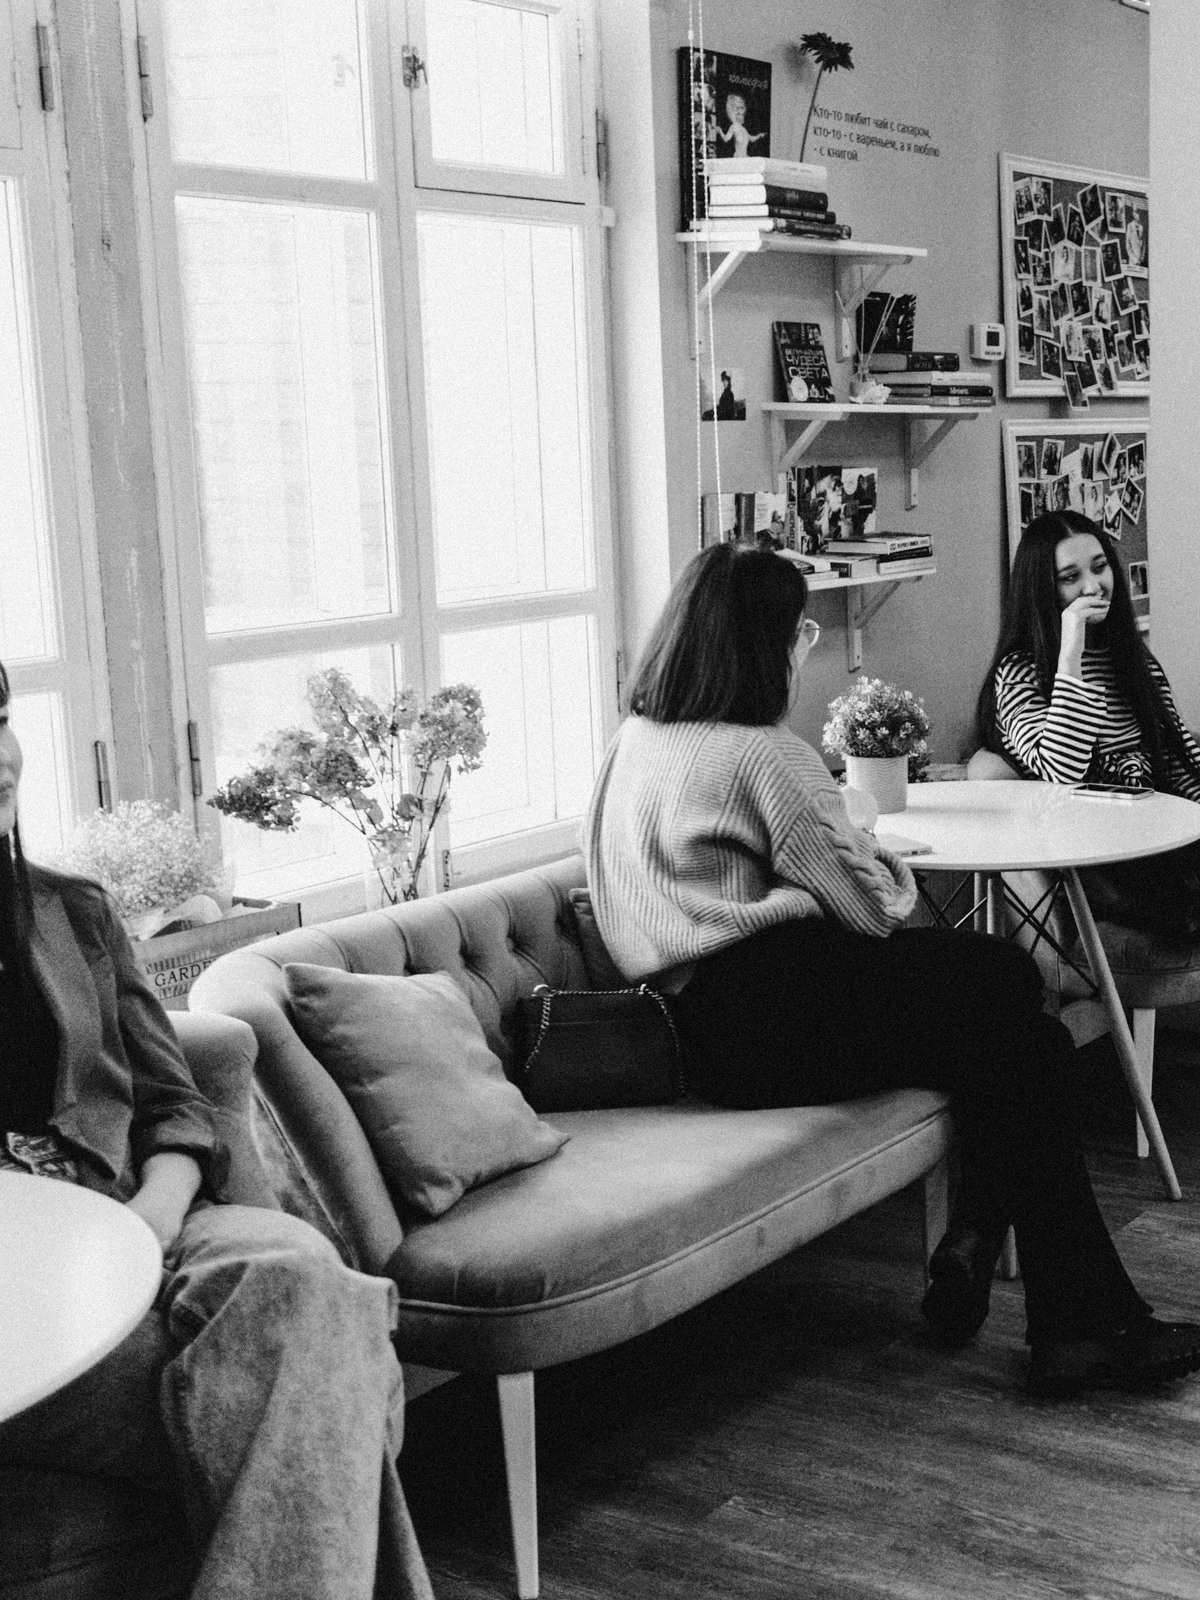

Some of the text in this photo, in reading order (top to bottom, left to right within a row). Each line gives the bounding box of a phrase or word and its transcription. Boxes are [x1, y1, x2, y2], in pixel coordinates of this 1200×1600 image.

[813, 104, 842, 121] Кто-то
[844, 112, 871, 126] любит
[873, 118, 888, 130] чай
[813, 126, 842, 140] кто-то
[914, 143, 940, 157] люблю
[786, 355, 826, 366] ЧУДЕСА
[789, 366, 829, 379] СВЕТА
[154, 958, 216, 987] GARDE
